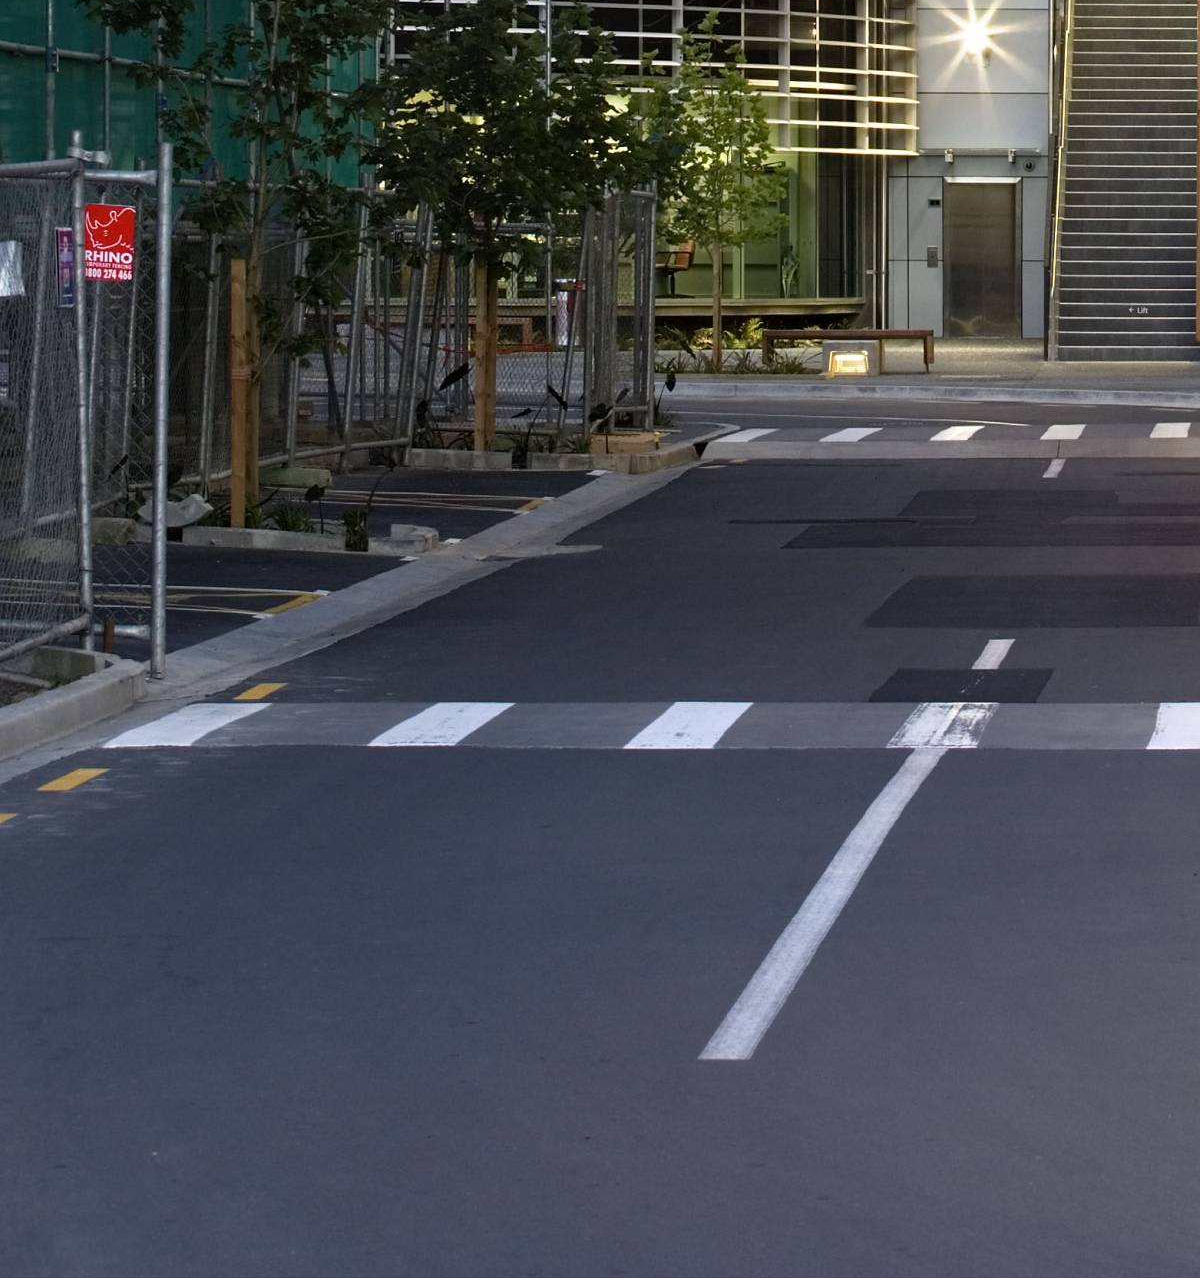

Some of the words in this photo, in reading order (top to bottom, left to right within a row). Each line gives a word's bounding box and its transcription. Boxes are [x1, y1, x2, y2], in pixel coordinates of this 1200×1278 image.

[84, 249, 133, 264] RHINO
[86, 261, 111, 269] EMPORARY
[103, 269, 117, 279] 274
[118, 270, 132, 281] 466
